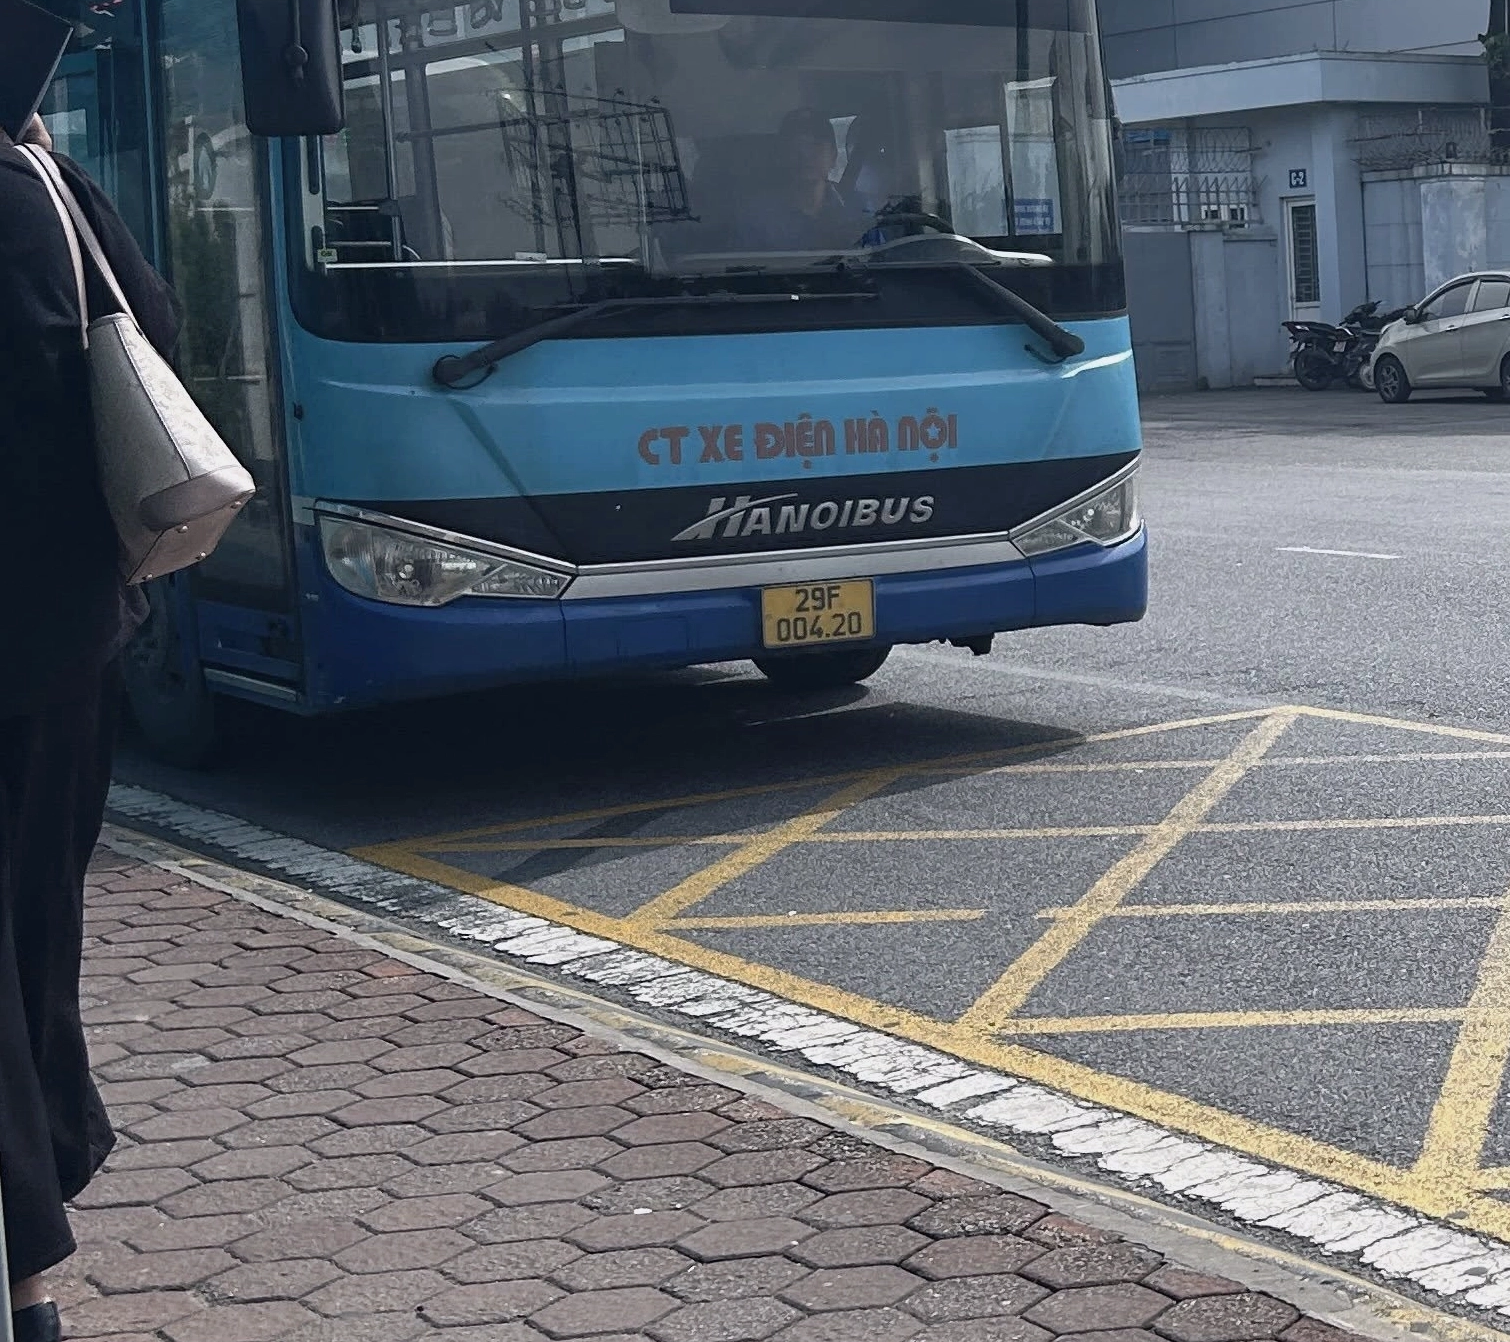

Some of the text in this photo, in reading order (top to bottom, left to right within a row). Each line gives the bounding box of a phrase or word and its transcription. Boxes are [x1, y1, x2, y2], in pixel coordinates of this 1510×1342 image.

[638, 425, 689, 466] CT
[698, 424, 744, 464] XE
[754, 412, 836, 469] ĐIỆN
[843, 409, 889, 456] HÀ
[795, 585, 841, 612] 29F
[777, 611, 862, 641] 004.20
